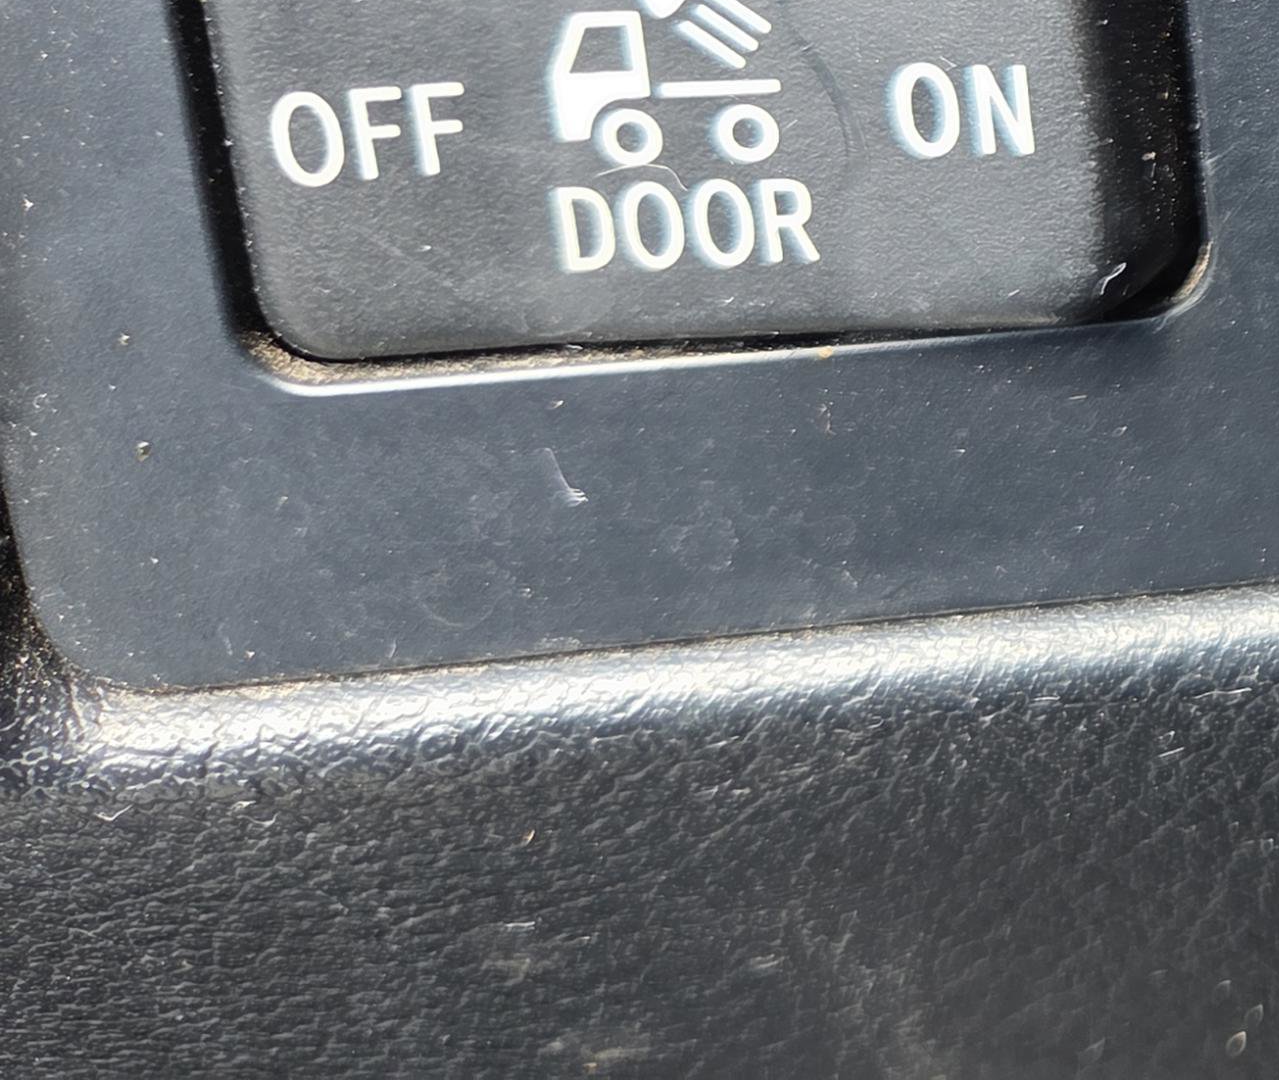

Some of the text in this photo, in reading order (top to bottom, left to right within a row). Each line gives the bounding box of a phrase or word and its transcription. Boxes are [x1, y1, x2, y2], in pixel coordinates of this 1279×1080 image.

[270, 81, 465, 188] OFF
[889, 61, 1036, 159] ON
[550, 177, 821, 273] DOOR
